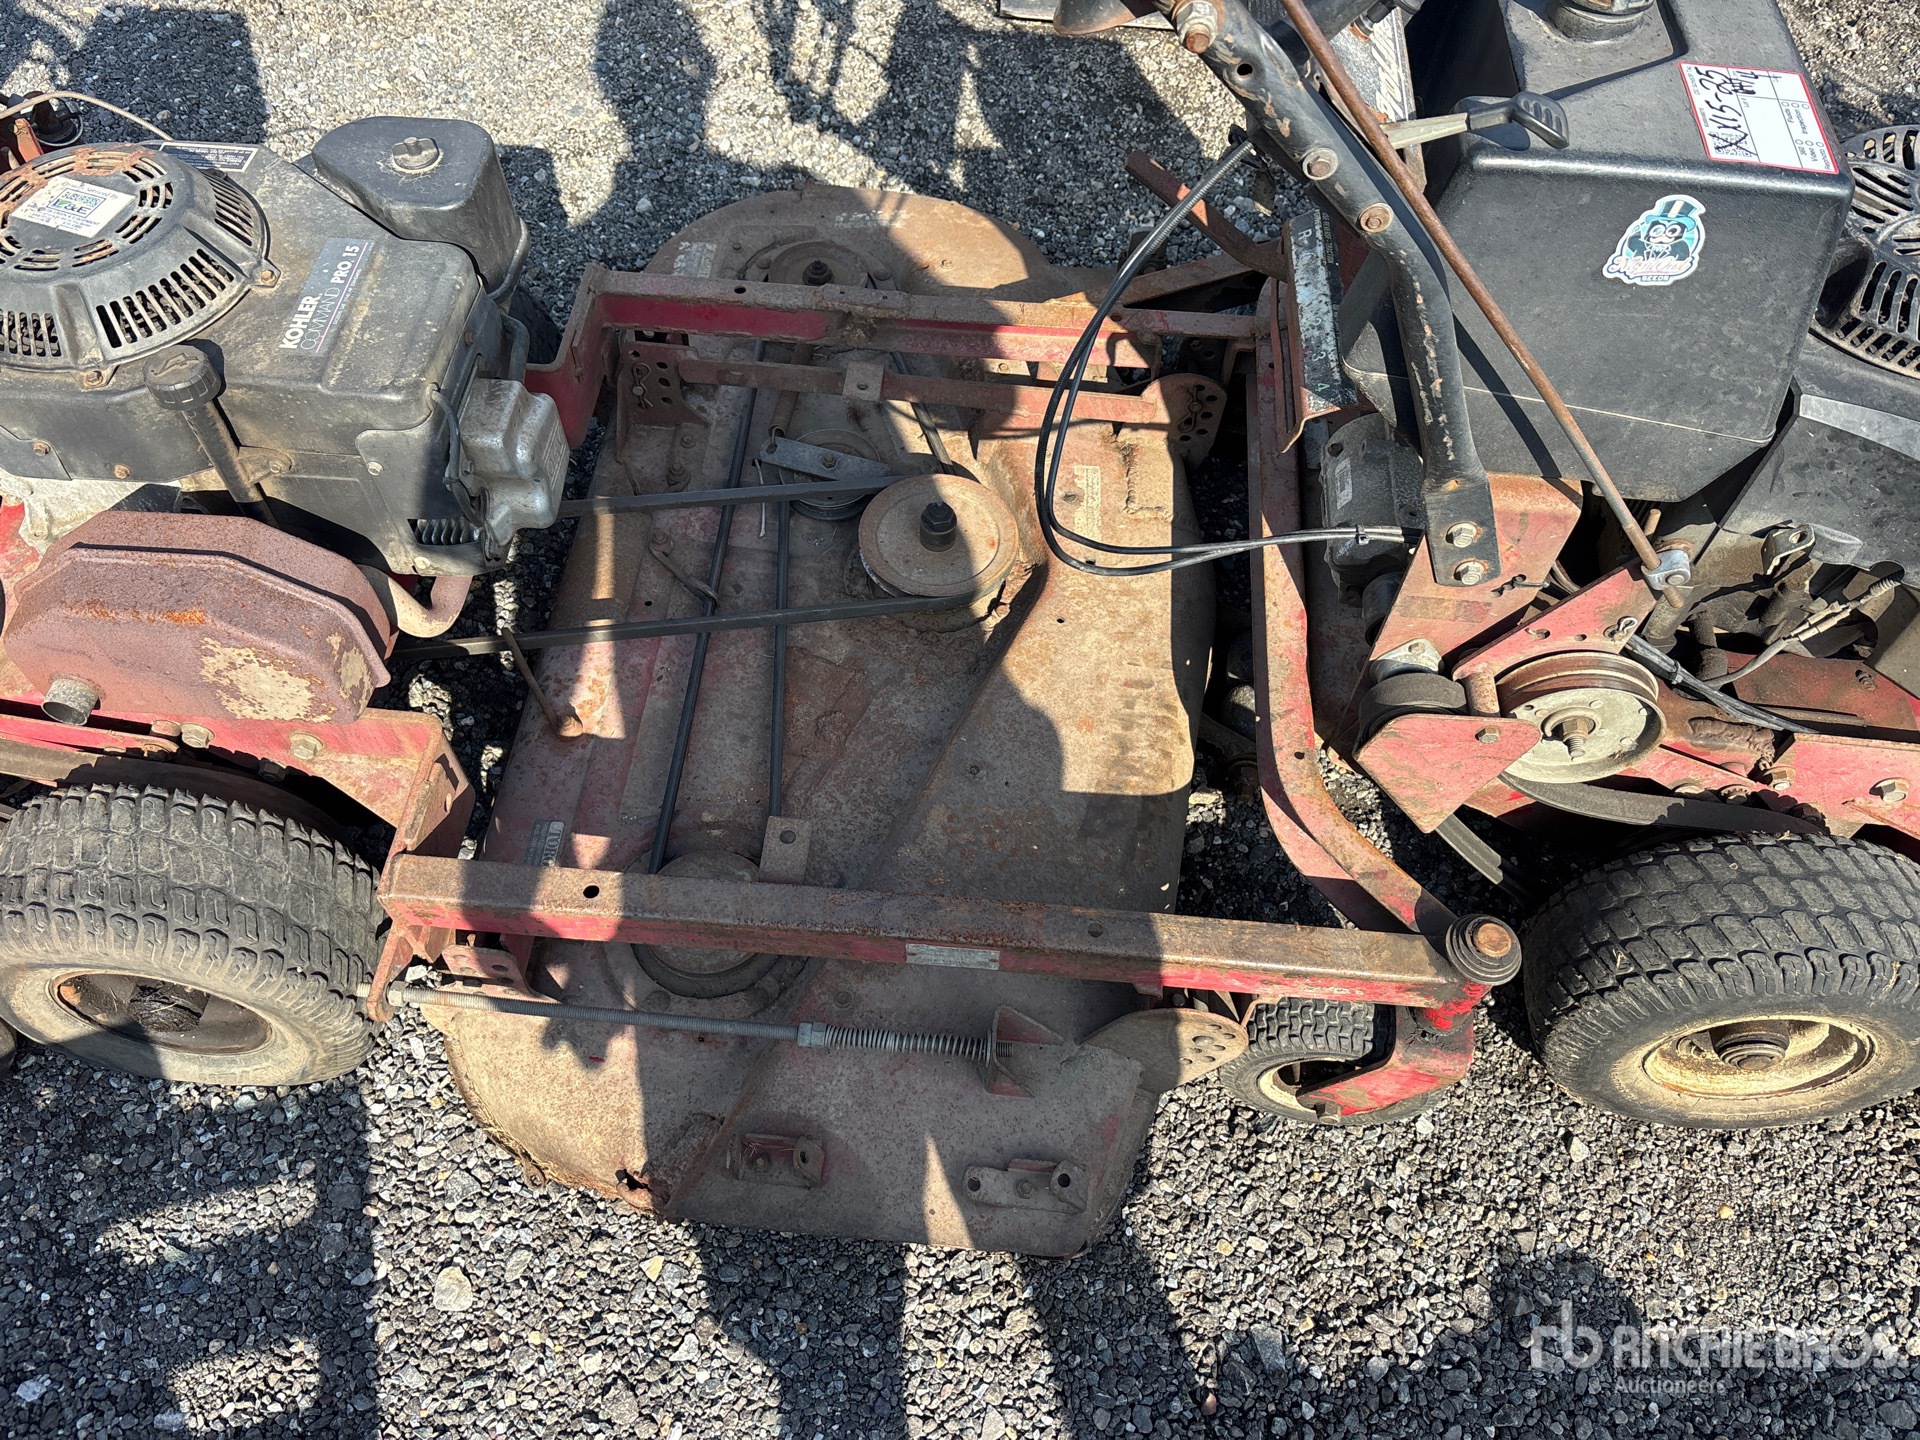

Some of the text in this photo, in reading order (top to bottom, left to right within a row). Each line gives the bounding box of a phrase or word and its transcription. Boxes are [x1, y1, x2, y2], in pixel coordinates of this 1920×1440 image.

[1784, 108, 1794, 123] Fluids
[1794, 109, 1808, 135] Inspection
[1808, 147, 1818, 162] Video
[52, 199, 92, 215] L&E
[61, 191, 102, 208] SUBURBAN
[1298, 228, 1312, 240] R
[300, 287, 341, 350] COMMAND
[330, 261, 352, 284] PRO
[342, 245, 360, 258] 15
[279, 295, 321, 349] KOHLER
[1312, 351, 1326, 362] 3
